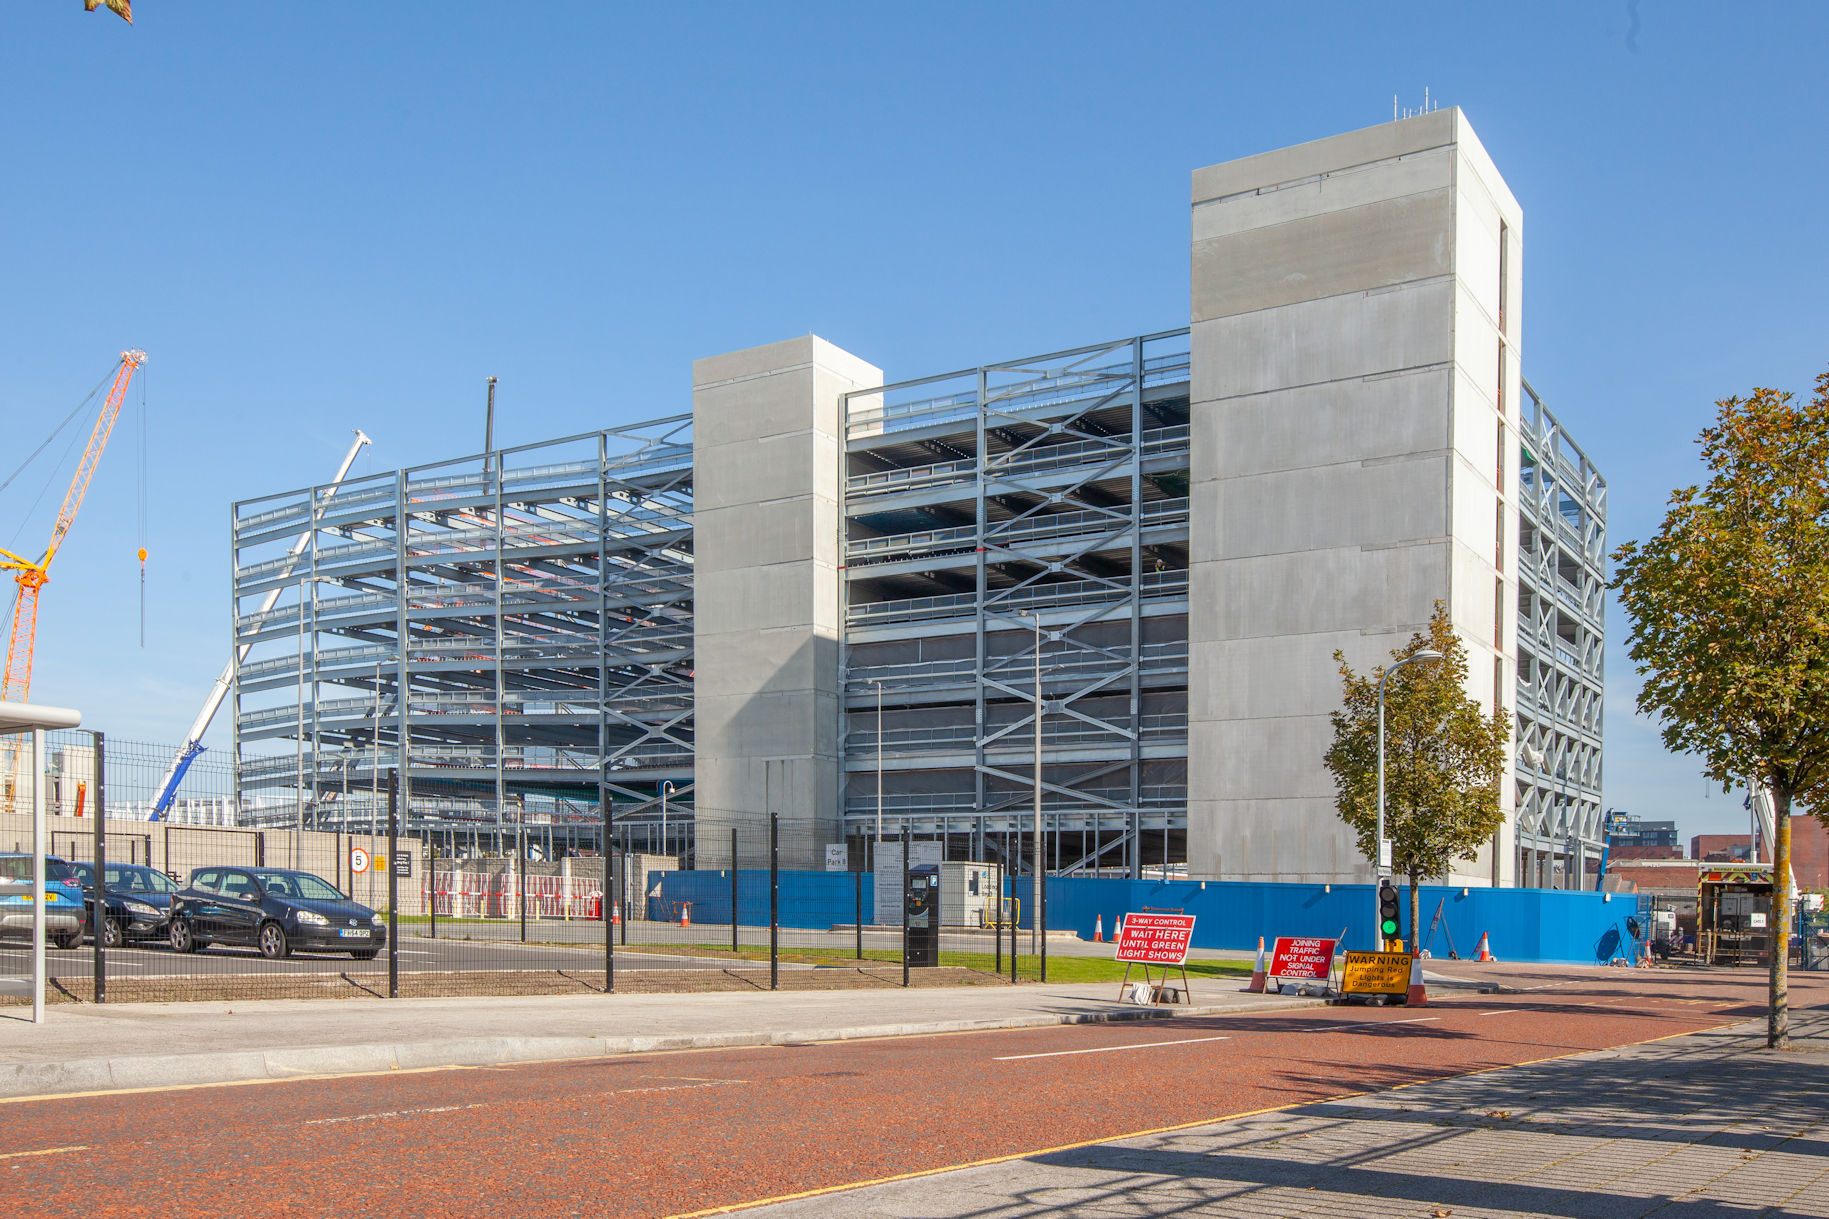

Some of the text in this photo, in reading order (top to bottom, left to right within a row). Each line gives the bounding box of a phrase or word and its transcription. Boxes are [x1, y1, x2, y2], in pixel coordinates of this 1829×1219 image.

[831, 848, 843, 856] Car
[355, 855, 362, 866] 5
[1154, 918, 1186, 926] CONTROL
[1131, 930, 1186, 941] WAIT HERE
[1122, 939, 1185, 950] UNTIL GREEN
[1291, 939, 1321, 947] JOINING
[1119, 949, 1183, 960] LIGHT SHOWS
[1289, 946, 1320, 955] TRAFFIC
[1299, 955, 1326, 963] UNDER
[1349, 955, 1409, 966] WARNING
[1287, 962, 1315, 970] SIGNAL
[1350, 965, 1384, 974] Jumping
[1280, 969, 1317, 978] CONTROL
[1359, 974, 1384, 982] Lights
[1352, 980, 1395, 988] Dangerous
